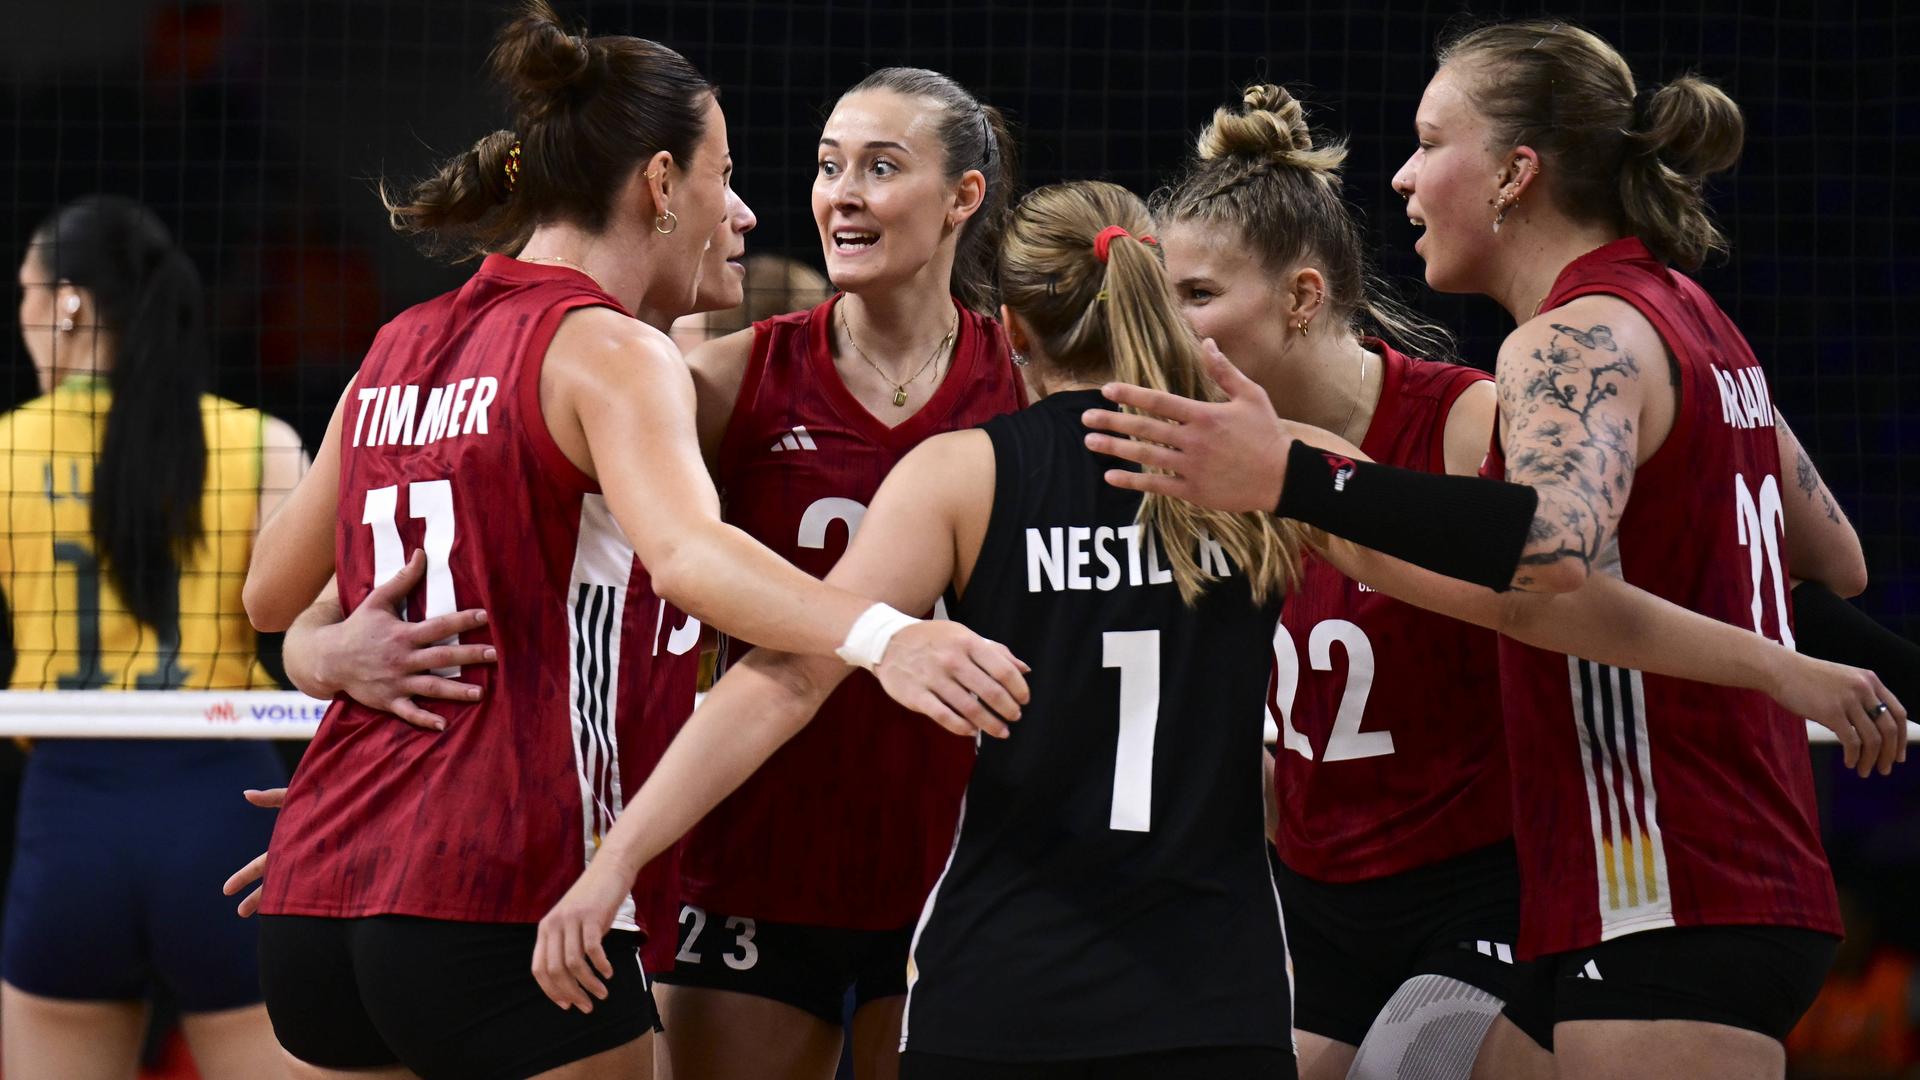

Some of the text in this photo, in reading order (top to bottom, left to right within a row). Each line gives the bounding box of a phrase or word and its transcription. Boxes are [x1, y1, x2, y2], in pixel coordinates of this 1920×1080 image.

[353, 376, 498, 448] TIMMER
[362, 480, 462, 679] 11
[1025, 526, 1233, 593] NESTLR
[1102, 629, 1160, 833] 1
[1272, 618, 1396, 763] 22
